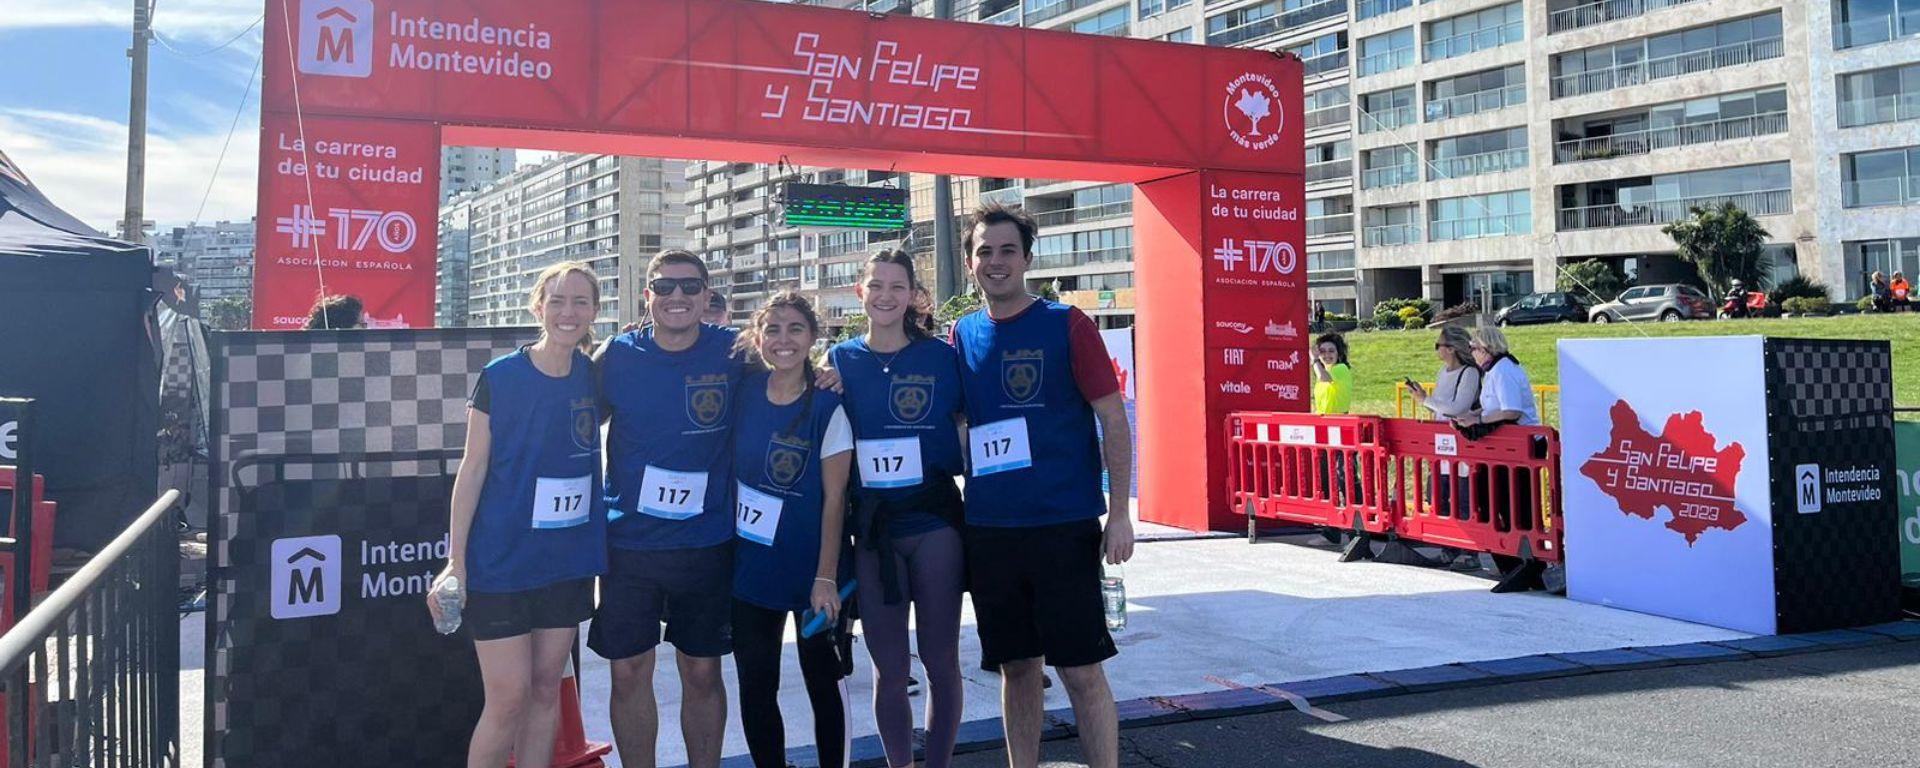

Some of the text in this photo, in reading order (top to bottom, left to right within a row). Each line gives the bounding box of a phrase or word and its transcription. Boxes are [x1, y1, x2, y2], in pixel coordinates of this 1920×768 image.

[390, 11, 551, 49] Intendencia
[389, 43, 552, 80] Montevideo
[1226, 72, 1279, 98] Montevideo
[278, 133, 397, 158] La carrera
[1230, 130, 1279, 150] más verde
[278, 157, 423, 184] de tu ciudad
[1211, 184, 1281, 202] La carrera
[1211, 203, 1297, 221] de tu ciudad
[276, 204, 417, 253] #170
[355, 260, 413, 271] ESPAÑOLA
[1213, 238, 1296, 275] #170
[1215, 321, 1247, 329] saucony
[1223, 348, 1245, 366] FIAT
[1219, 380, 1252, 394] vitale
[983, 437, 1012, 459] 117
[872, 455, 904, 473] 117
[1825, 464, 1881, 484] Intendencia
[553, 494, 583, 512] 117
[658, 486, 691, 505] 117
[1826, 484, 1882, 504] Montevideo
[1679, 502, 1720, 521] 2023
[361, 532, 450, 565] Intend
